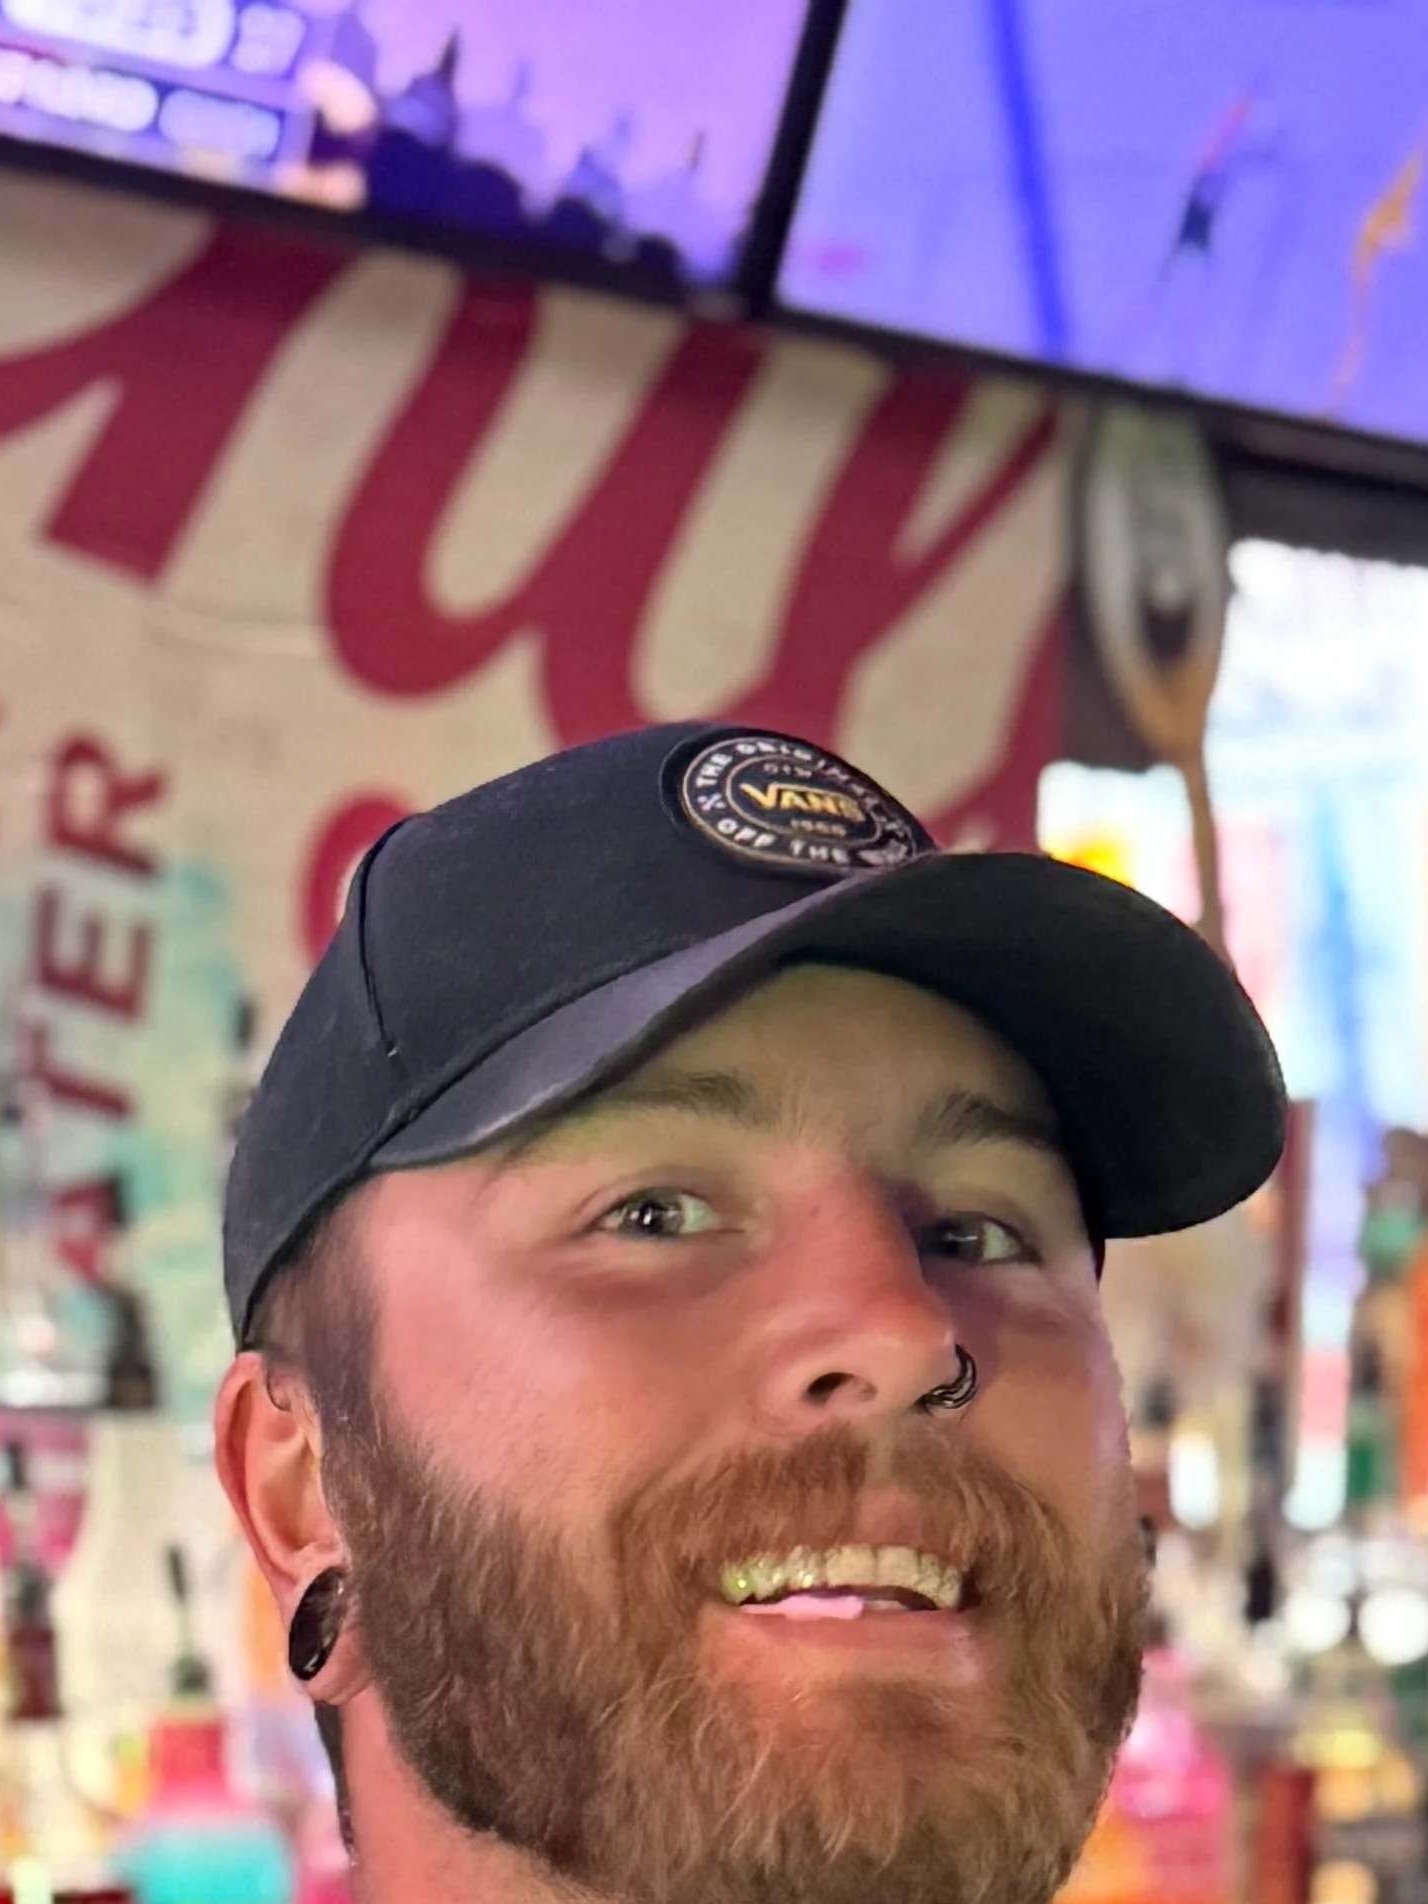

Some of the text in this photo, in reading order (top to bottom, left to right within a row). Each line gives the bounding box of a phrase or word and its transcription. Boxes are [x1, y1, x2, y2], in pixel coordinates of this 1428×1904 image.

[695, 752, 733, 788] THE
[739, 782, 866, 822] VANS
[717, 818, 777, 848] OFF
[790, 838, 851, 864] THE
